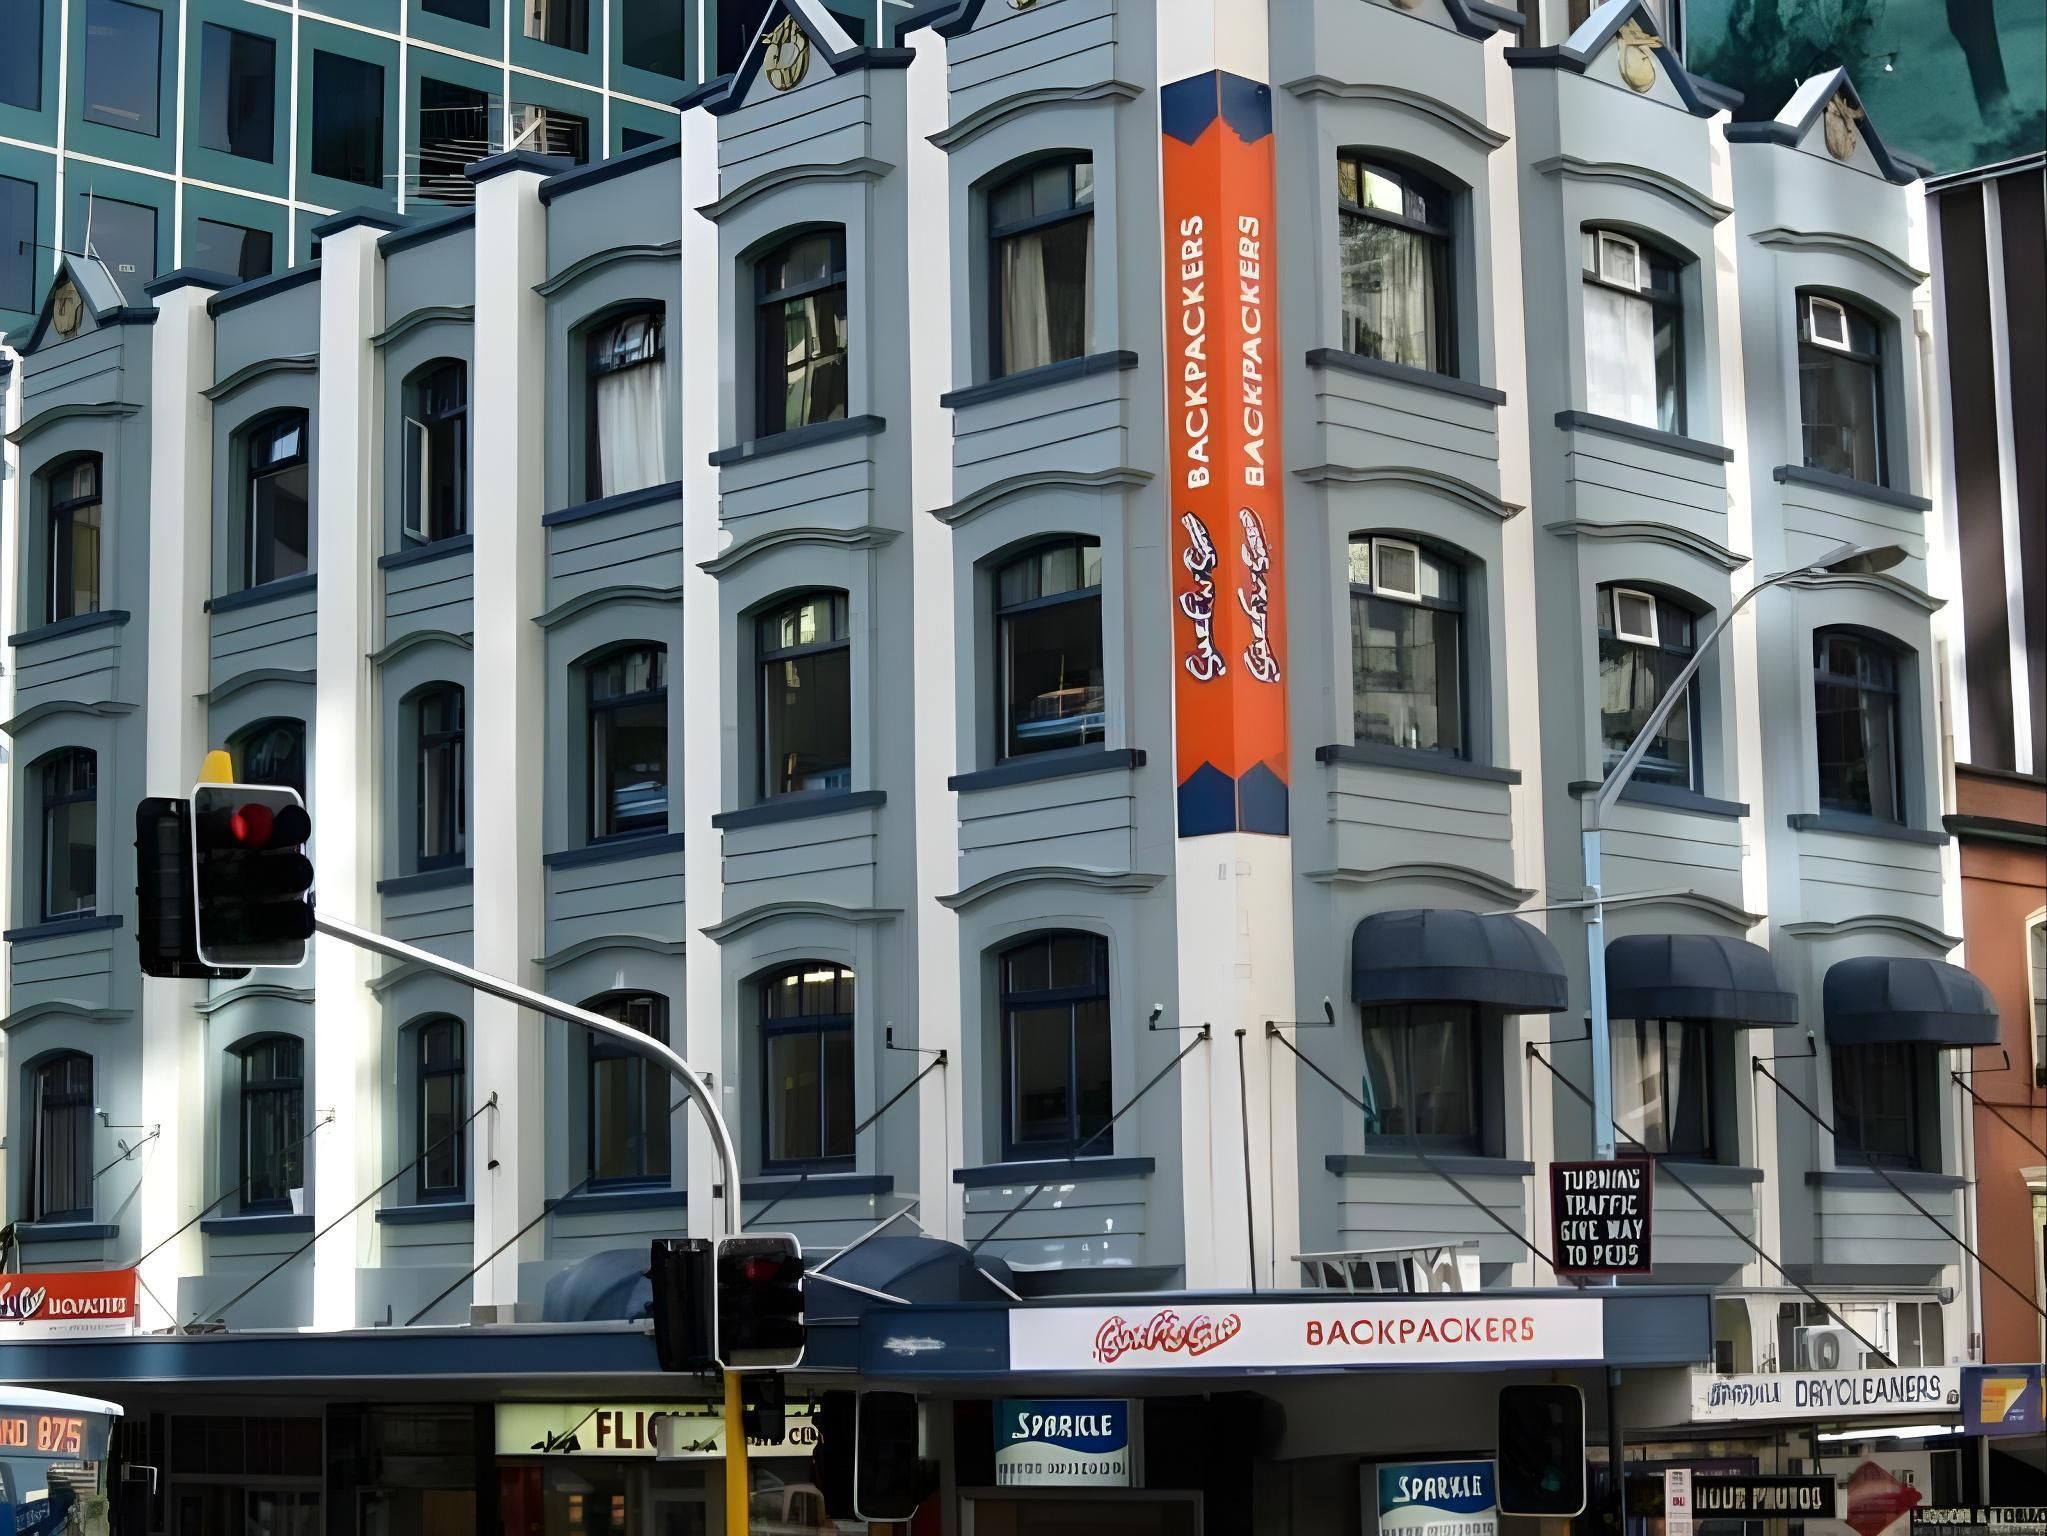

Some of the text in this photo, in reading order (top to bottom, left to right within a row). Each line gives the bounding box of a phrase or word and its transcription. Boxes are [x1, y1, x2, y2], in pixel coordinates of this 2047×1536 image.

[1180, 216, 1209, 488] BACKPACKERS
[1238, 216, 1264, 486] BACKPACKERS
[1563, 1168, 1640, 1191] TURNING
[1565, 1195, 1638, 1216] TRAFFIC
[1560, 1219, 1643, 1241] GIVE WAY
[1566, 1244, 1639, 1266] TO PEDS
[1307, 1316, 1534, 1346] BACKPACKERS
[1011, 1412, 1112, 1439] SPARKLE
[1392, 1475, 1482, 1503] SPARKLE
